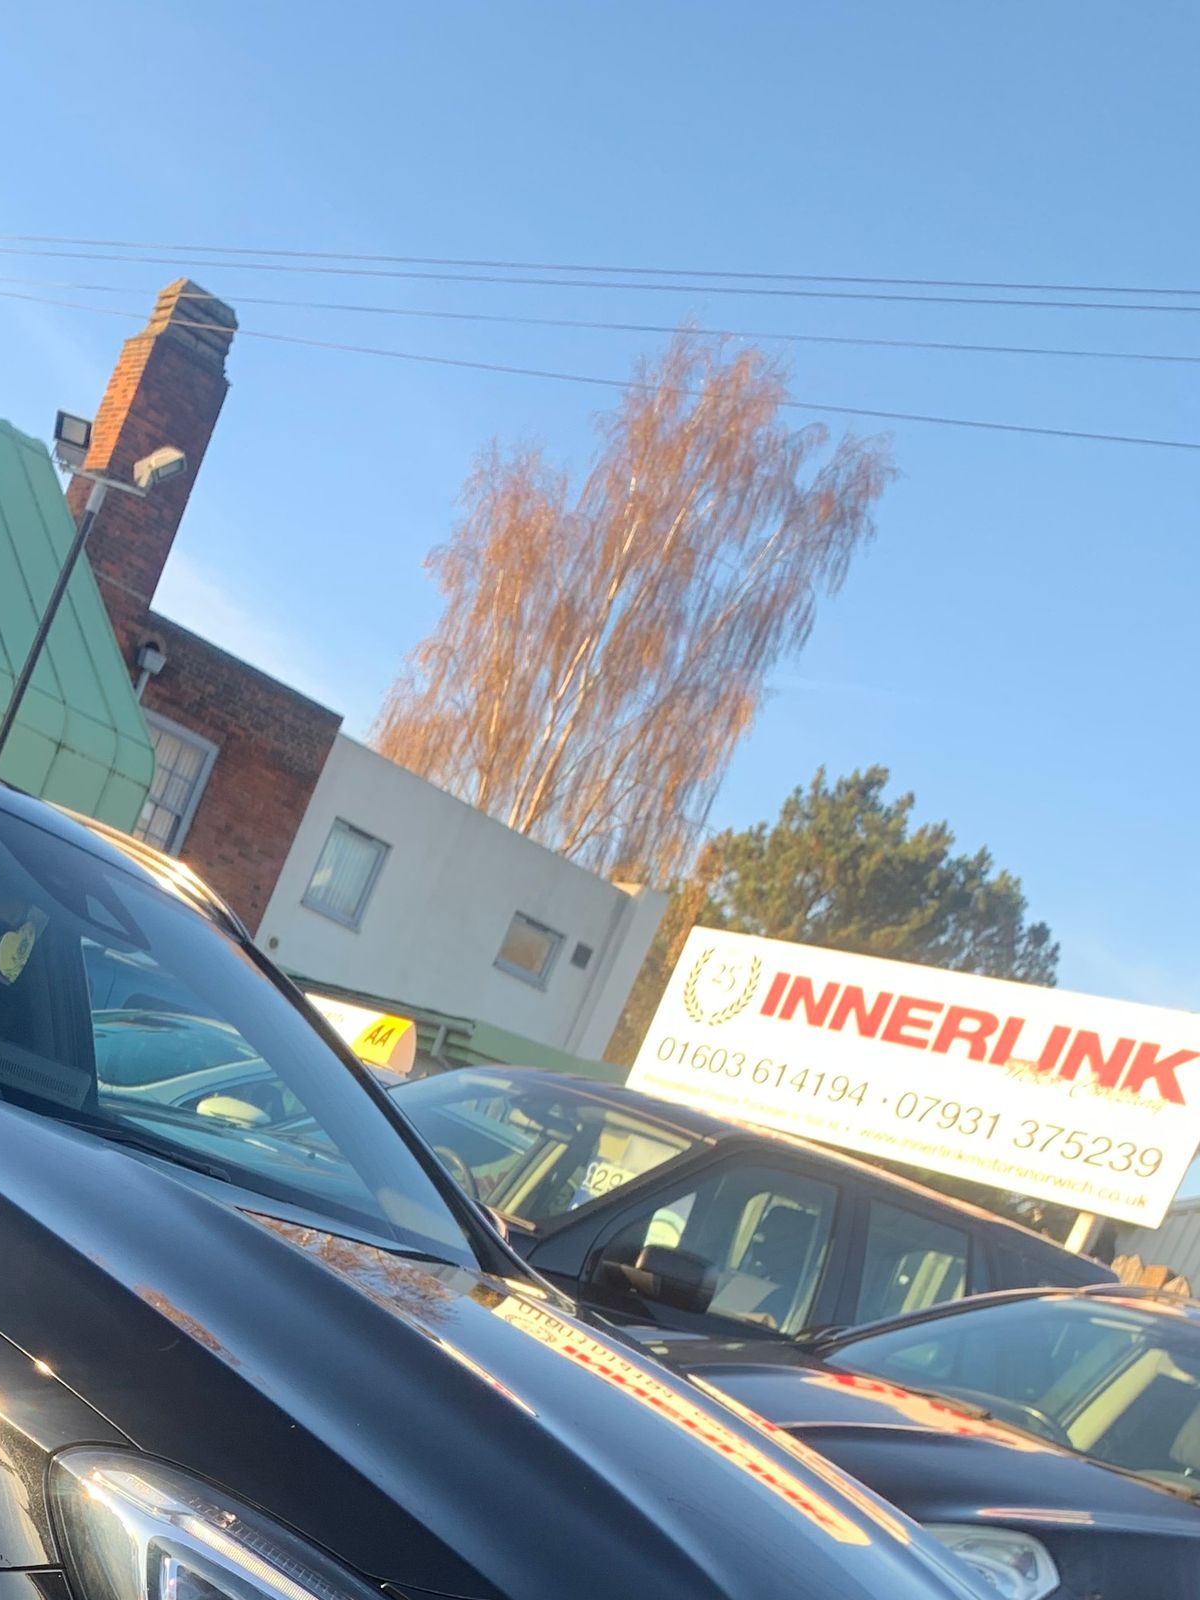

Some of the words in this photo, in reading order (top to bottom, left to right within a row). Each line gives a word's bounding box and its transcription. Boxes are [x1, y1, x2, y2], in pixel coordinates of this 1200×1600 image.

[363, 1024, 396, 1047] AA
[759, 971, 1200, 1106] INNERLINK
[656, 1036, 745, 1078] 01603
[751, 1058, 869, 1108] 614194
[895, 1092, 1002, 1140] 07931
[1012, 1119, 1164, 1180] 375239
